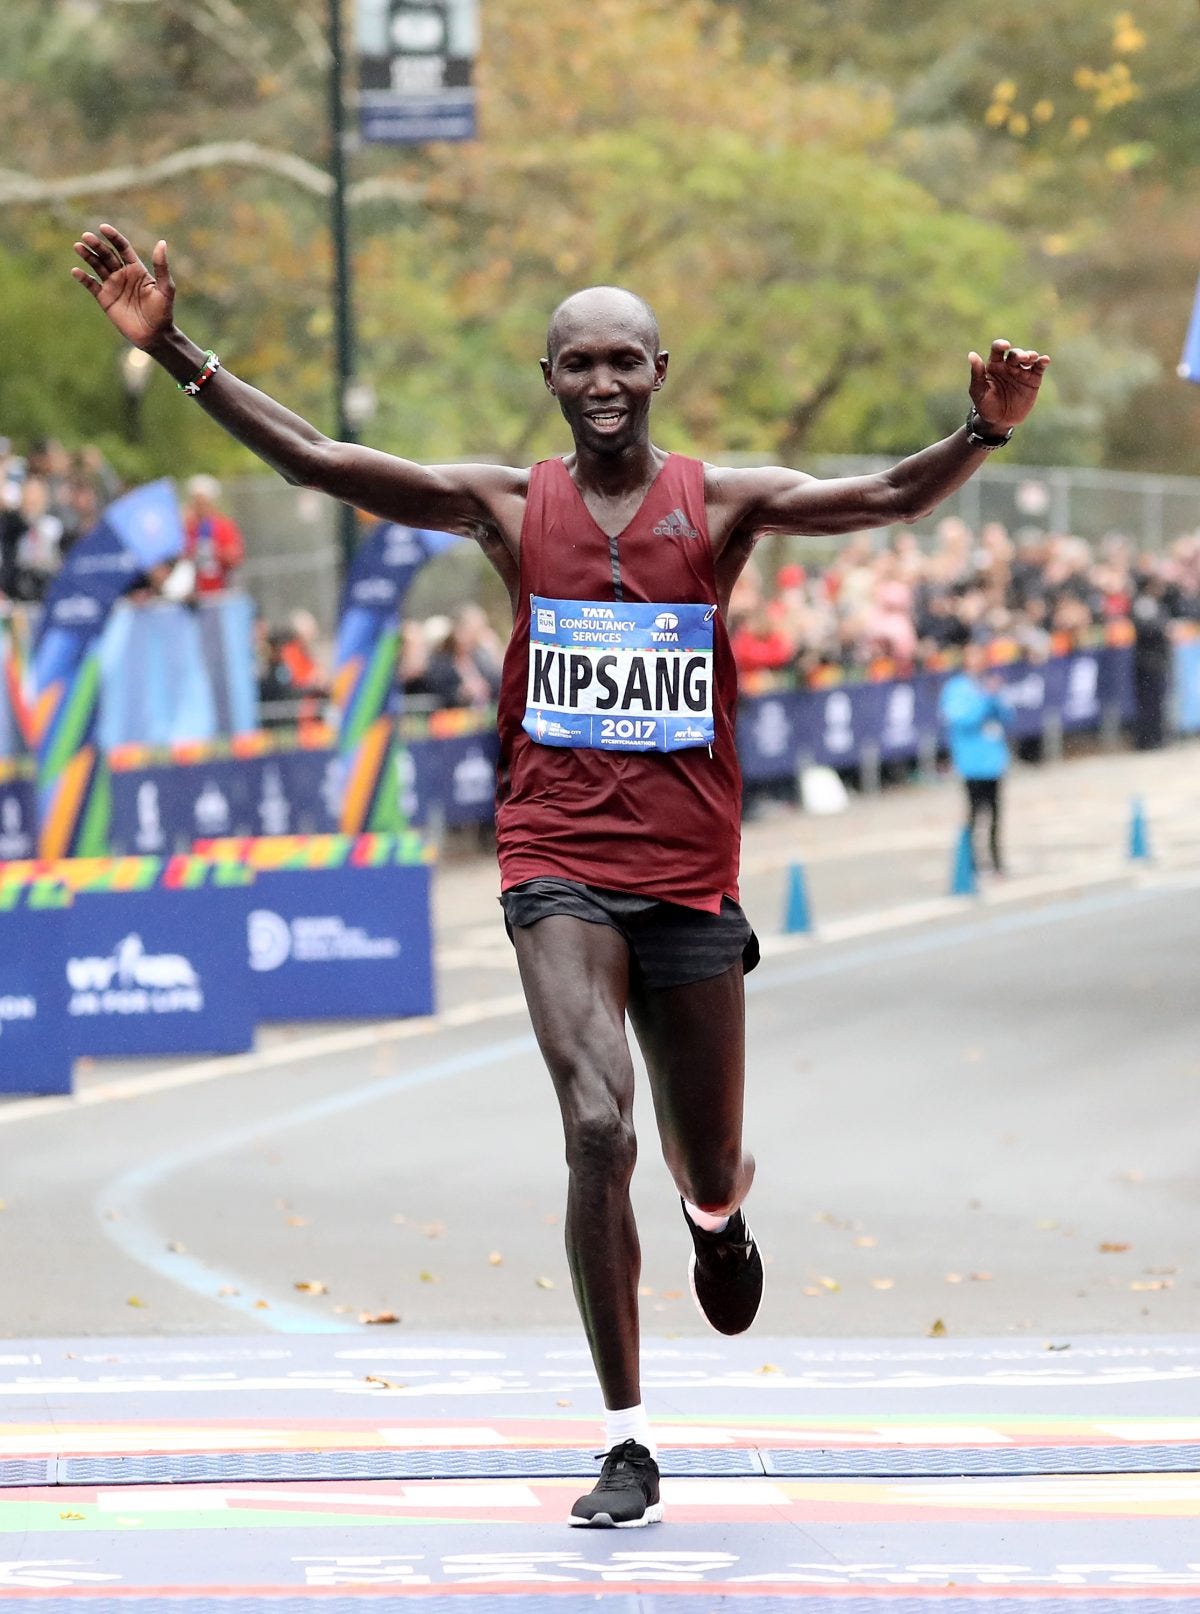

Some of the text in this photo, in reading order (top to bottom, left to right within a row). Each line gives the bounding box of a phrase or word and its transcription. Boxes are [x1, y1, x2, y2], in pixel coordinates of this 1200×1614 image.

[653, 524, 698, 538] adidas
[581, 608, 615, 619] TATA
[559, 618, 636, 631] CONSULTANCY
[572, 631, 622, 643] SERVICES
[650, 632, 679, 642] TATA
[532, 648, 707, 712] KIPSANG
[600, 719, 657, 738] 2017
[306, 1562, 1200, 1575] NEW YOR
